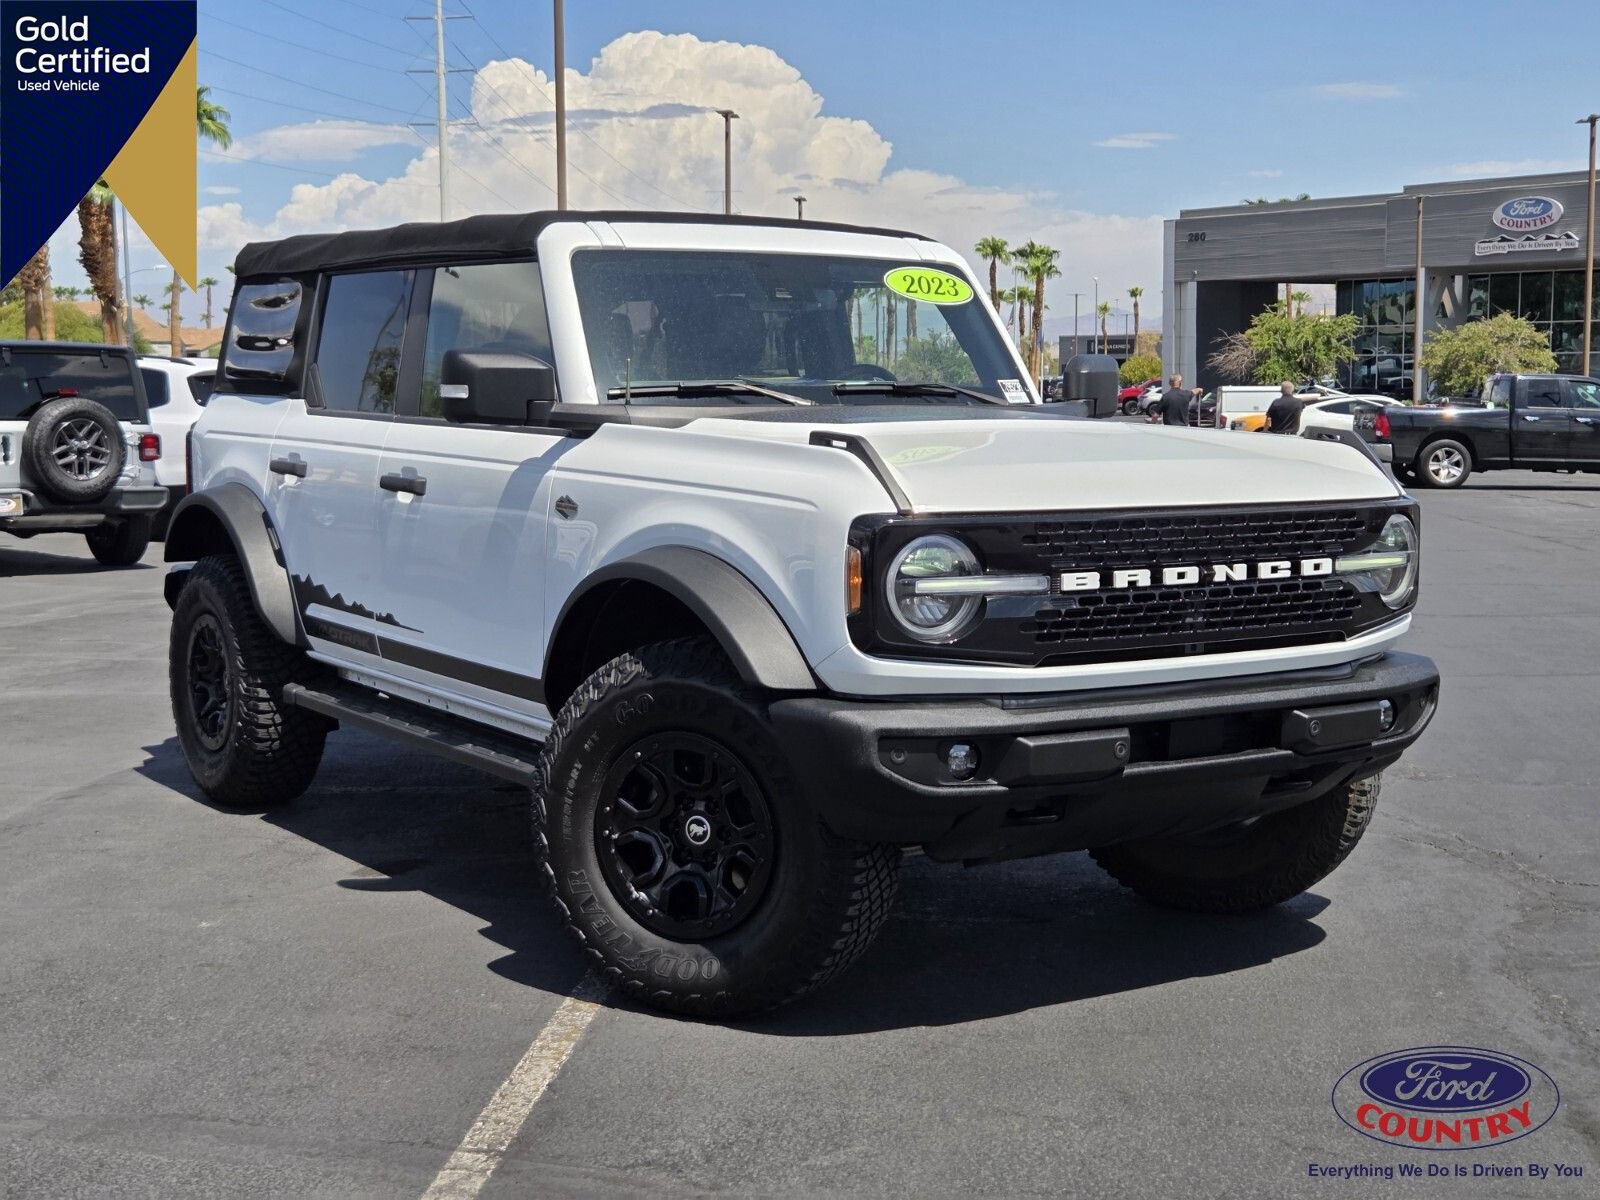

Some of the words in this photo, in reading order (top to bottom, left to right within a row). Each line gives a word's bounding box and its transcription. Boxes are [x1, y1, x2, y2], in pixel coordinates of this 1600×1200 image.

[1510, 200, 1544, 216] Ford
[1500, 213, 1554, 229] COUNTRY
[902, 274, 959, 297] 2023
[1060, 558, 1332, 591] BRONCO
